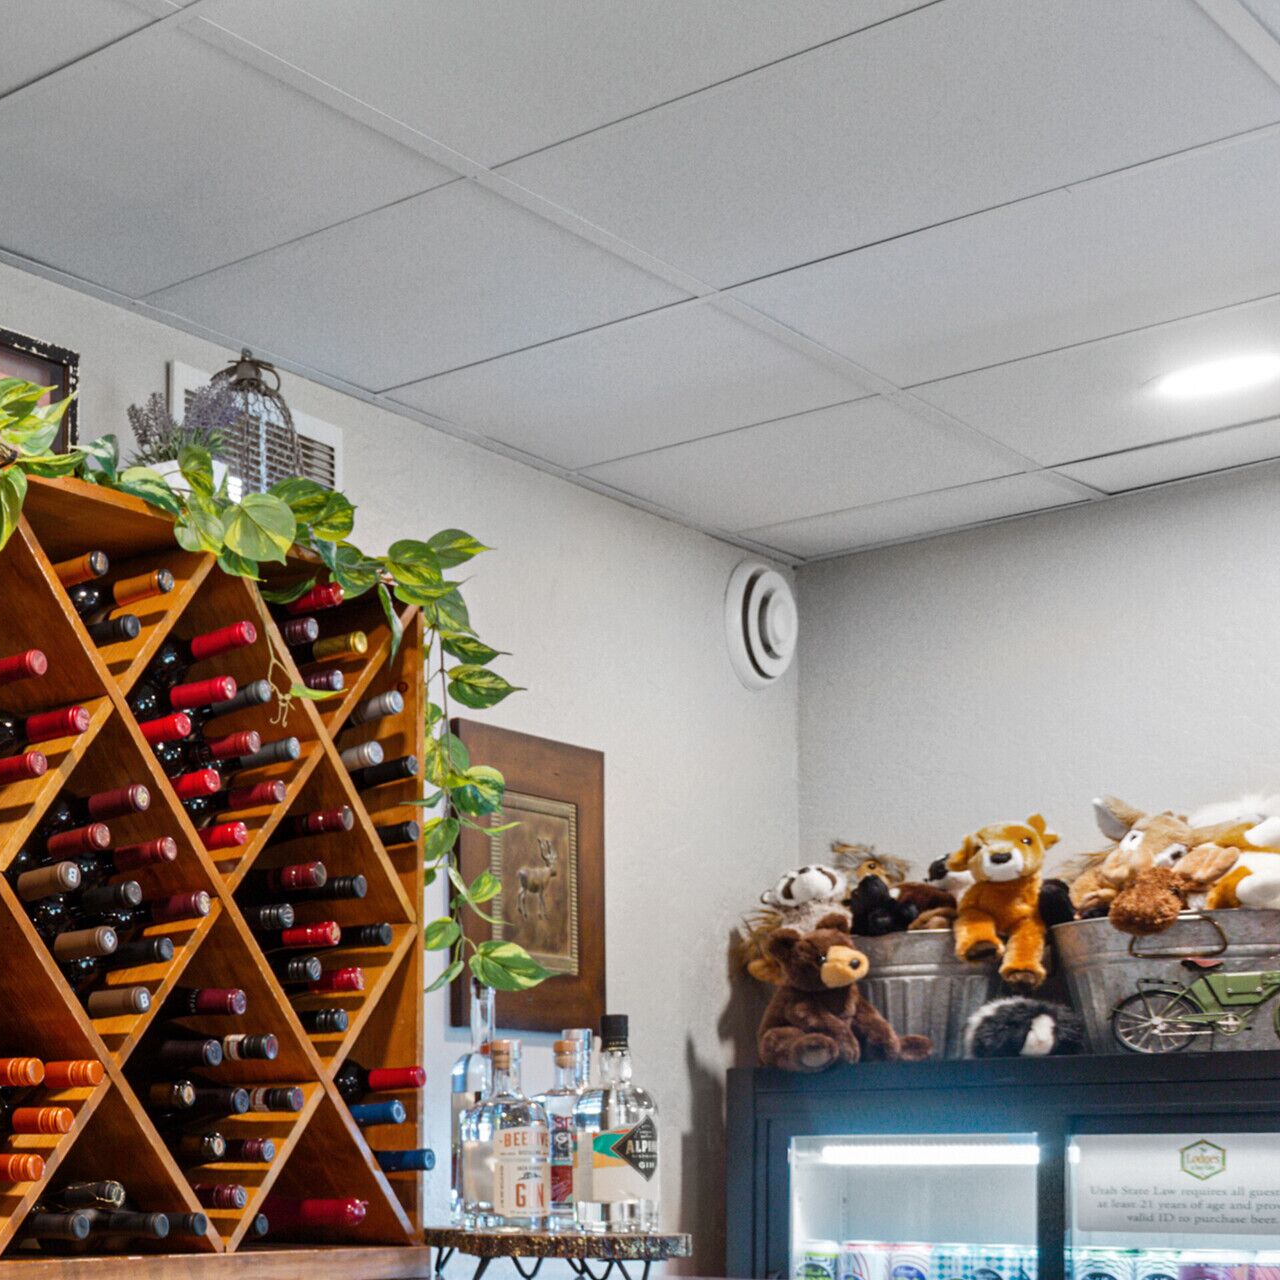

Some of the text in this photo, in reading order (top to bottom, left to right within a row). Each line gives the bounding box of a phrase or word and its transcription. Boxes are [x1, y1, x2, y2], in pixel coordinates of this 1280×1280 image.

[1089, 1186, 1118, 1195] Utah
[1121, 1186, 1150, 1195] State
[1153, 1186, 1175, 1195] Law
[1180, 1186, 1226, 1197] requires
[1231, 1186, 1244, 1196] all
[1110, 1200, 1137, 1208] least
[1141, 1201, 1152, 1209] 21
[1158, 1201, 1187, 1211] years
[1190, 1200, 1202, 1209] of
[1206, 1203, 1225, 1212] age
[1230, 1201, 1251, 1210] and
[1127, 1213, 1154, 1222] valid
[1158, 1214, 1174, 1222] ID
[1194, 1214, 1247, 1225] purchase
[1250, 1215, 1278, 1225] beer.
